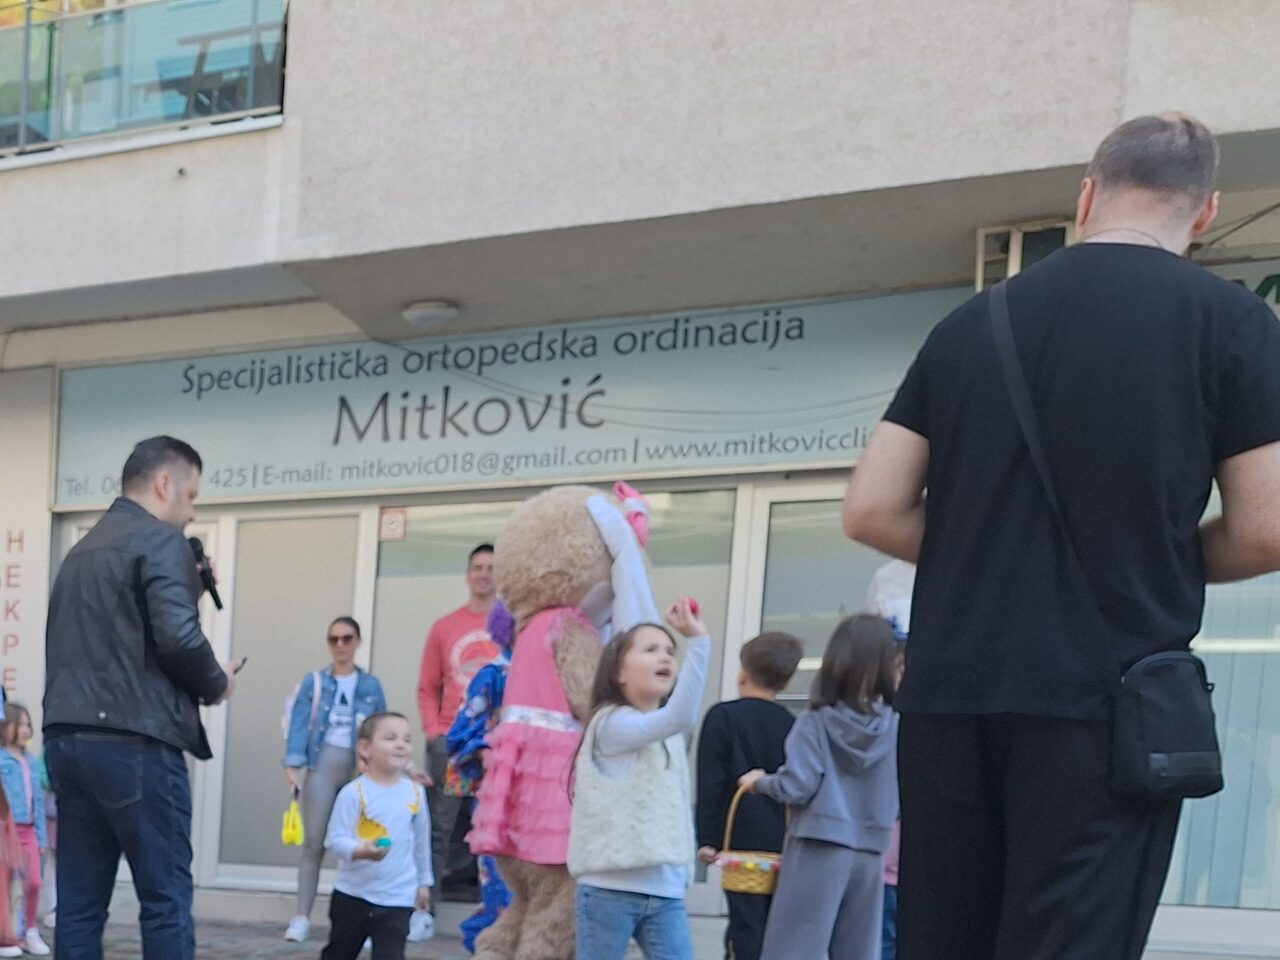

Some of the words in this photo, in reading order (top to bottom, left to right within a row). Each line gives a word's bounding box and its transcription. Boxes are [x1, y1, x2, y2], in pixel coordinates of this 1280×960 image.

[182, 348, 390, 400] Specijalistička
[402, 330, 598, 376] ortopedska
[613, 309, 805, 356] ordinacija
[332, 373, 607, 446] Mitković
[65, 477, 92, 496] Tel.
[262, 463, 332, 486] E-mail:
[340, 446, 627, 481] mitkovic018@gmail.com
[2, 530, 24, 691] НЕКРЕ
